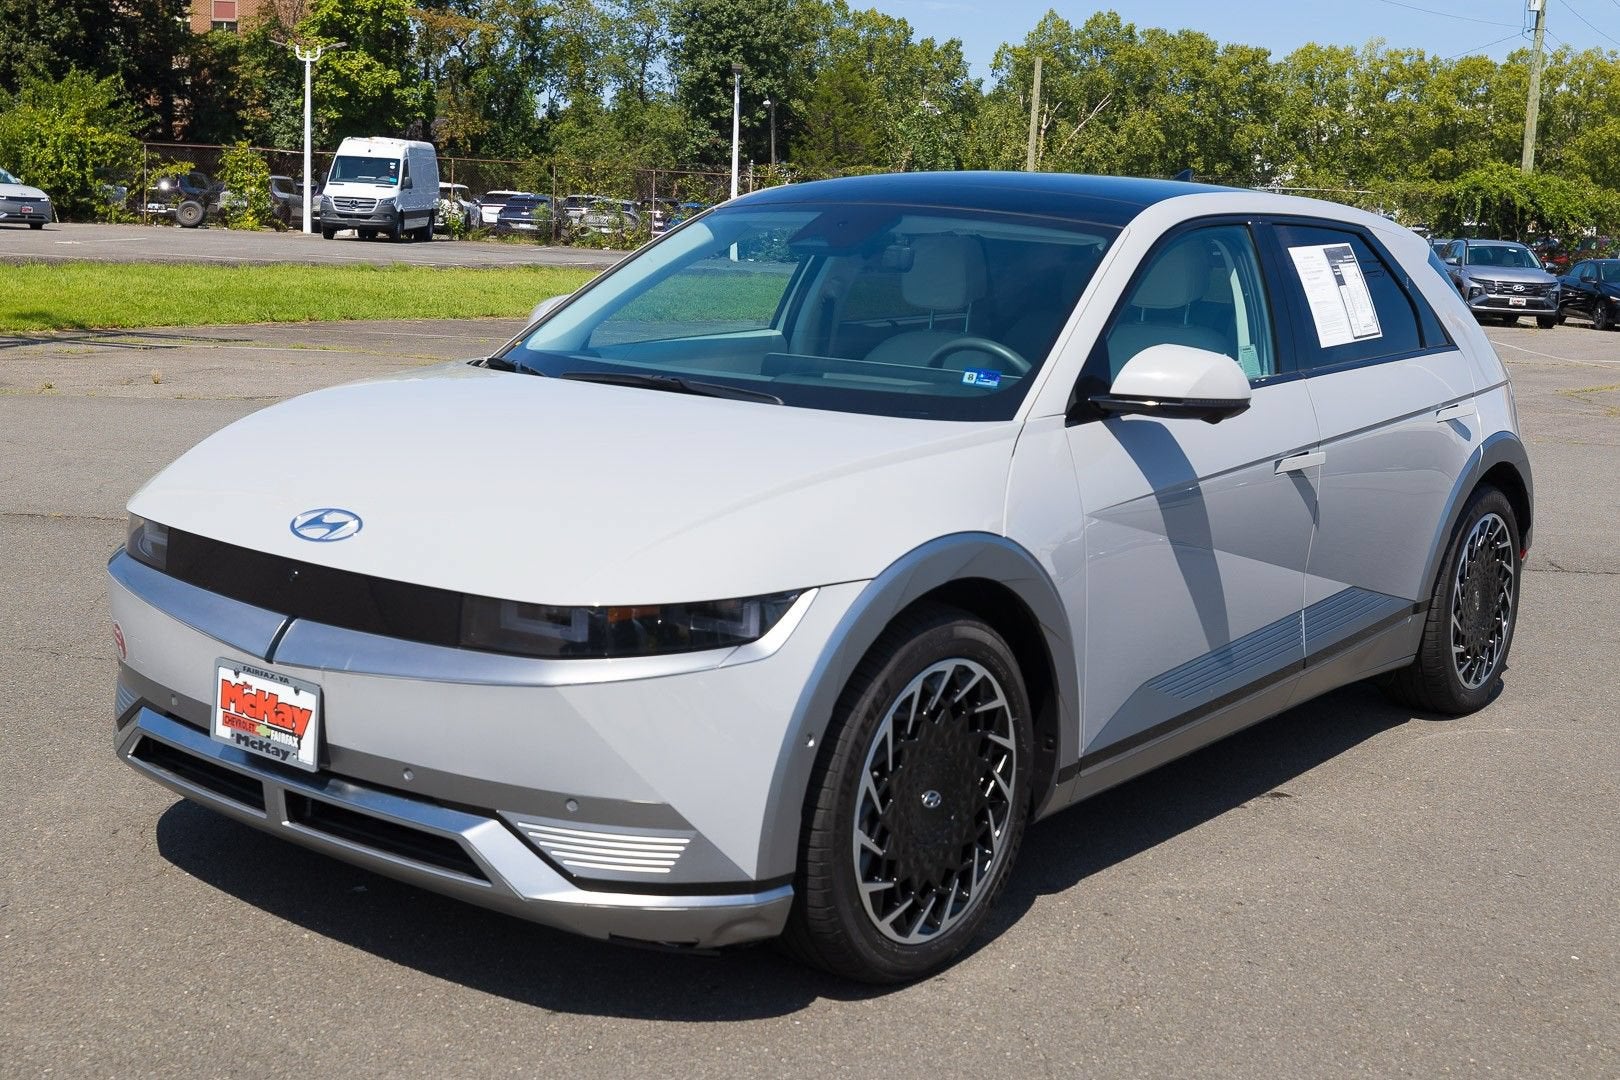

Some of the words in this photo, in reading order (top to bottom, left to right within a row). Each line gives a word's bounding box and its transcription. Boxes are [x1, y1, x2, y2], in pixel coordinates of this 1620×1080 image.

[279, 675, 290, 684] VA
[221, 679, 313, 740] McKay
[224, 714, 257, 733] CHEVROLET
[270, 730, 299, 748] FAIRFAX
[235, 733, 290, 761] McKay
